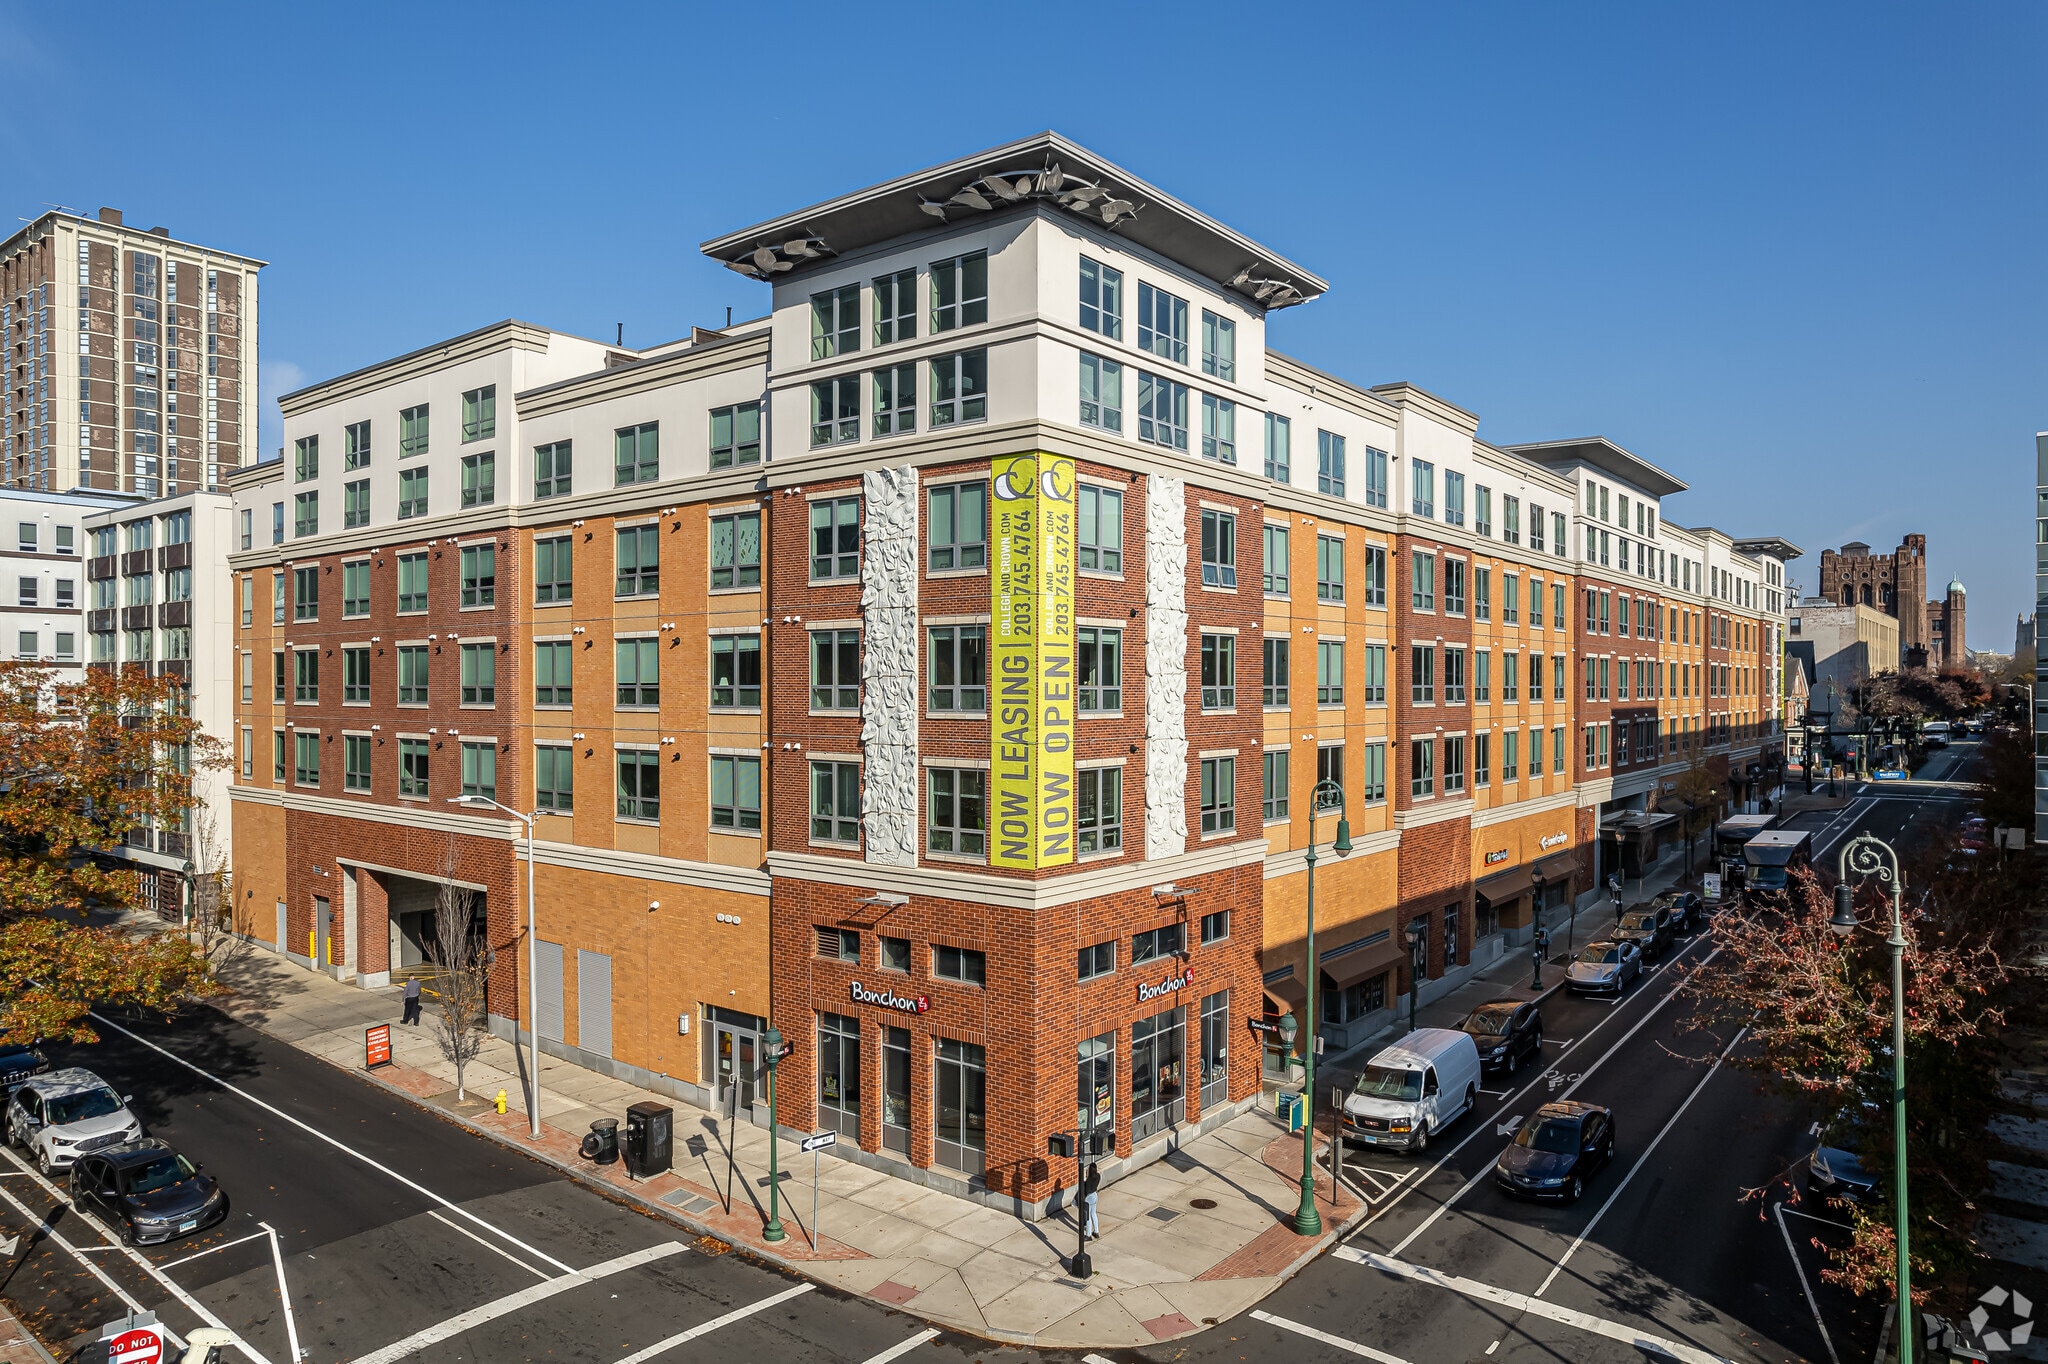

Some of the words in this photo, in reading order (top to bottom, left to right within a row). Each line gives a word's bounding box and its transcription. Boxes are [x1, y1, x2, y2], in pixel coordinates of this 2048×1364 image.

[1001, 513, 1011, 636] COLLEGEANDCROWN.COM
[1013, 510, 1031, 636] 203.745.4764
[1045, 511, 1054, 635] COLLEGEANDCROWN.COM
[1056, 513, 1069, 636] 203.745.4764
[1001, 656, 1029, 780] LEASING
[1044, 656, 1070, 753] OPEN
[1000, 790, 1029, 860] NOW
[1044, 771, 1070, 857] NOW
[852, 981, 917, 1013] Bonchon
[1139, 975, 1186, 1002] Bonchon
[1251, 1020, 1272, 1030] Bonchon
[109, 1344, 125, 1355] DO
[131, 1335, 154, 1349] NOT
